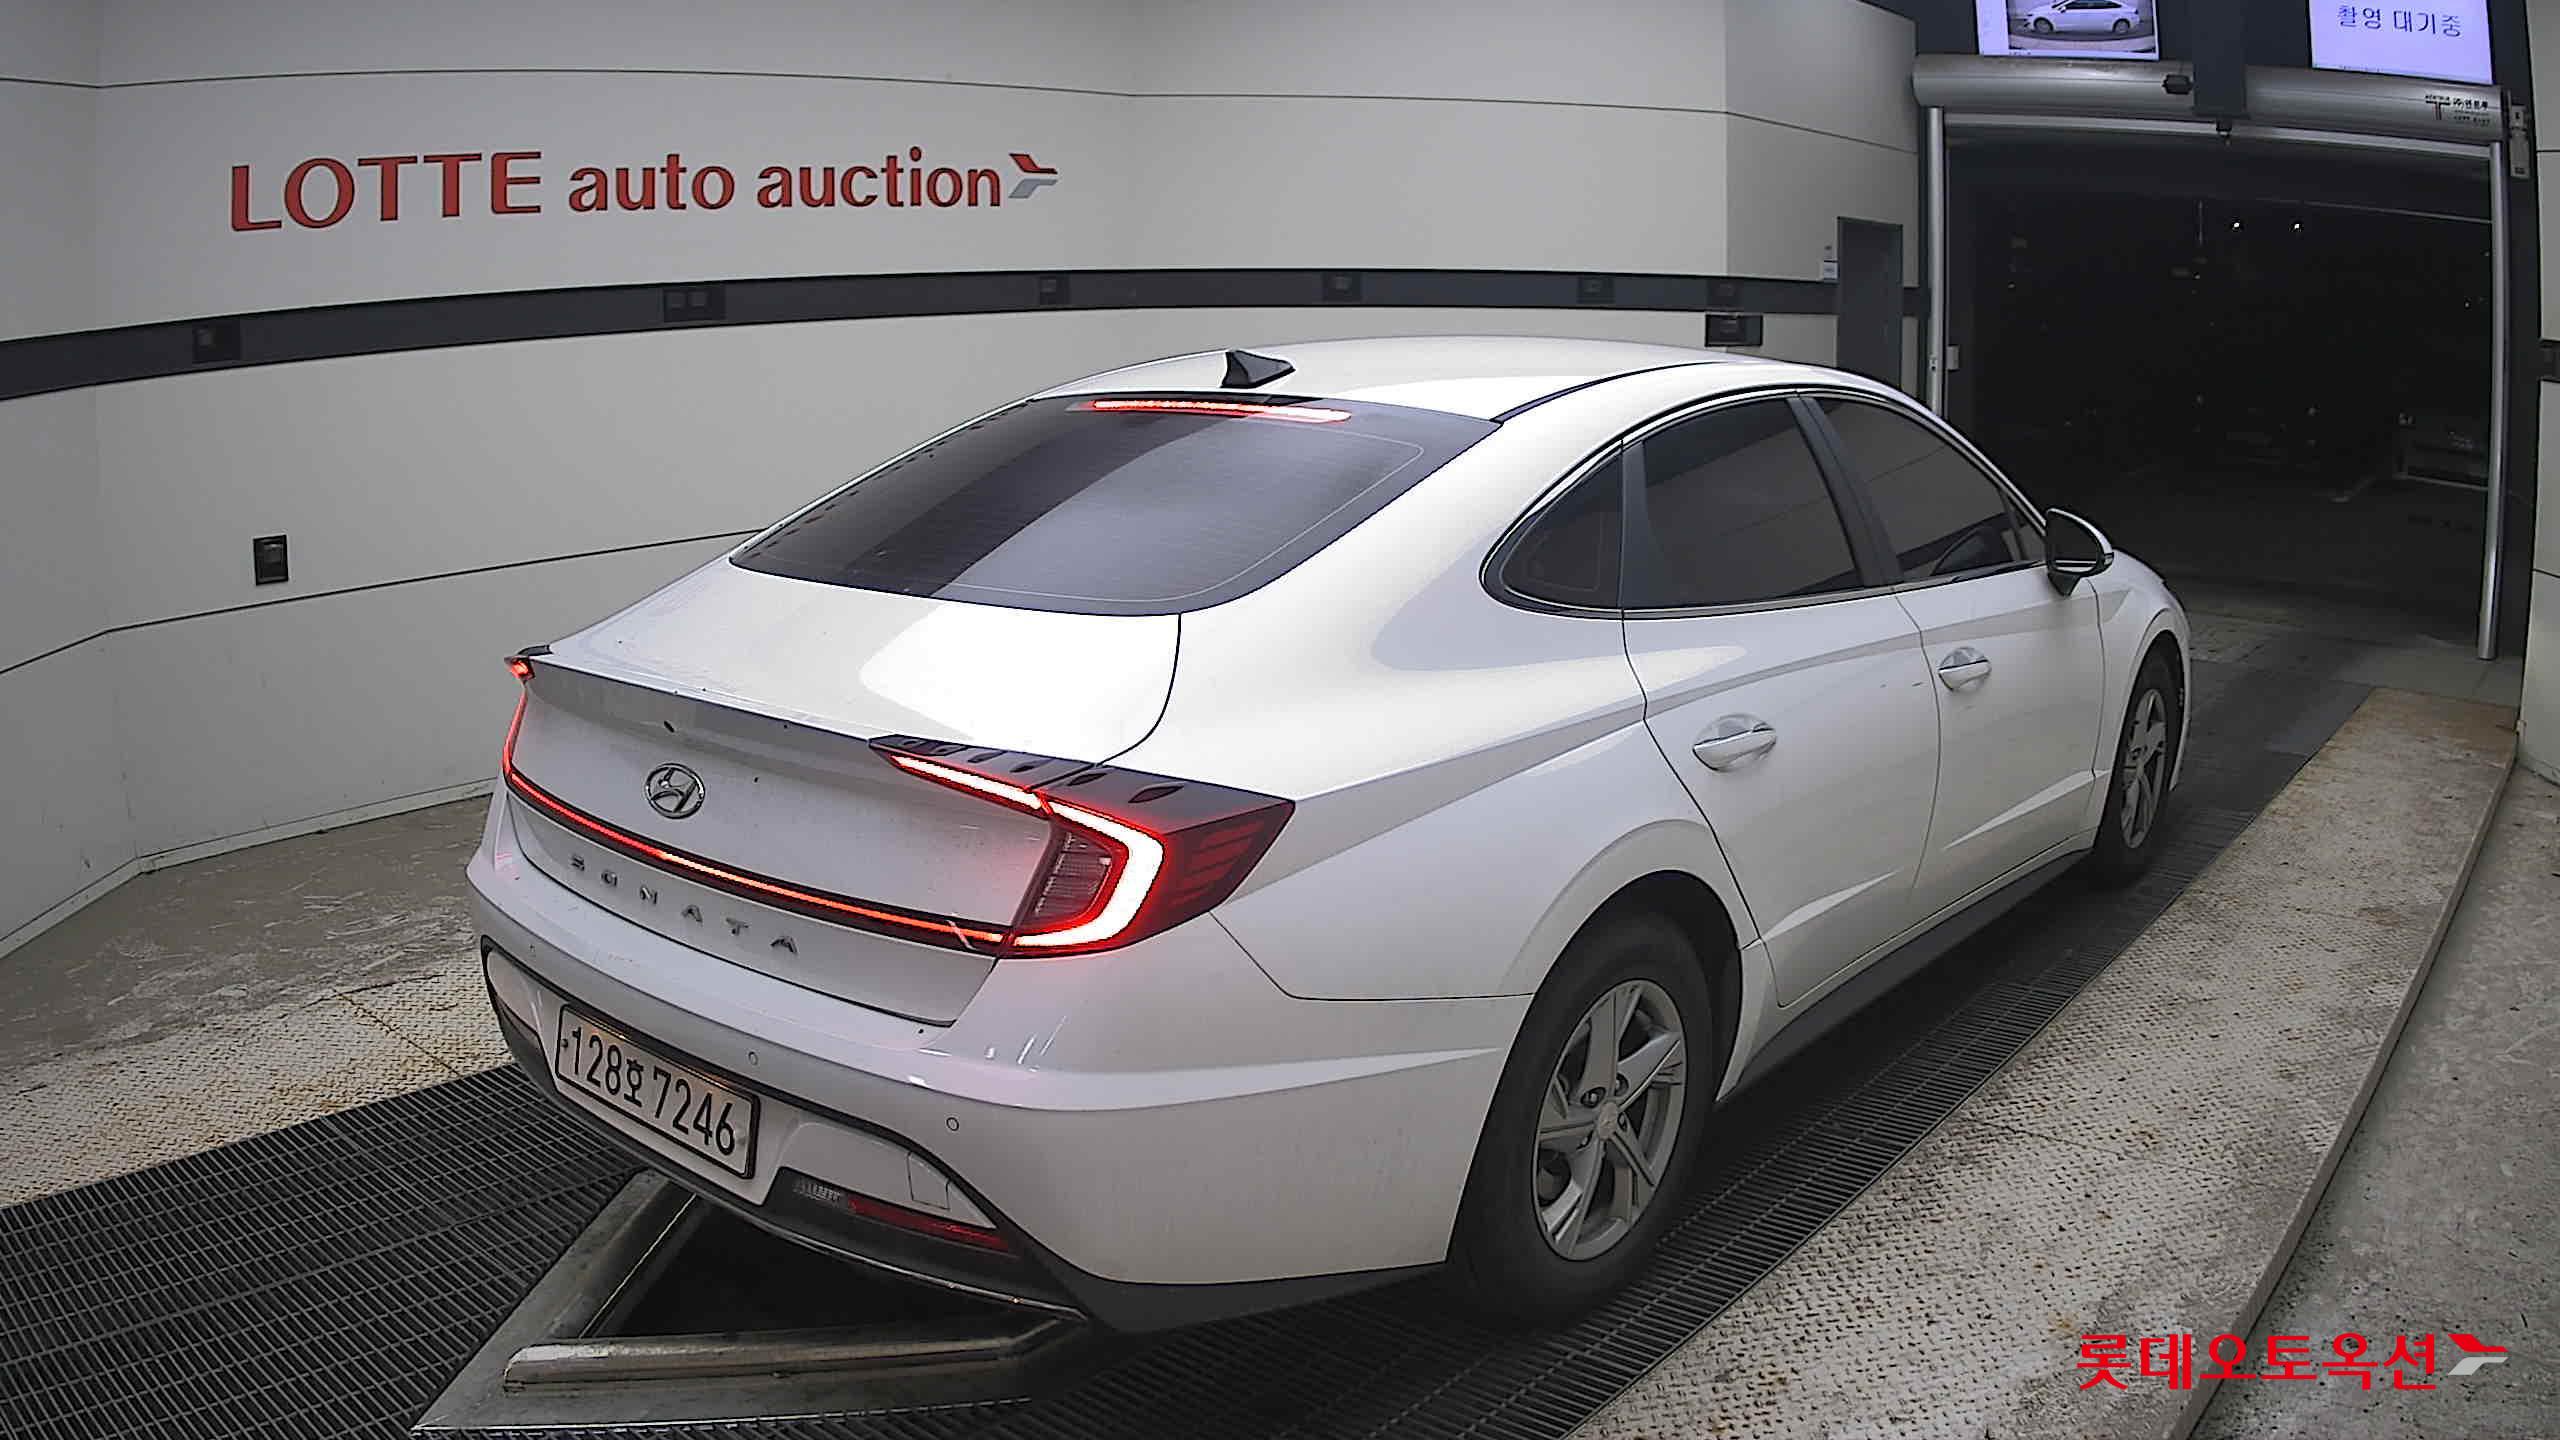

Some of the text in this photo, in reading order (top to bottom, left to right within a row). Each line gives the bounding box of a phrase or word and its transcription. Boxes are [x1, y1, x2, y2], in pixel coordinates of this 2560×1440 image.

[2392, 9, 2462, 38] 대기중
[231, 146, 1001, 232] LOTTE auto auction
[571, 853, 798, 955] SONATA
